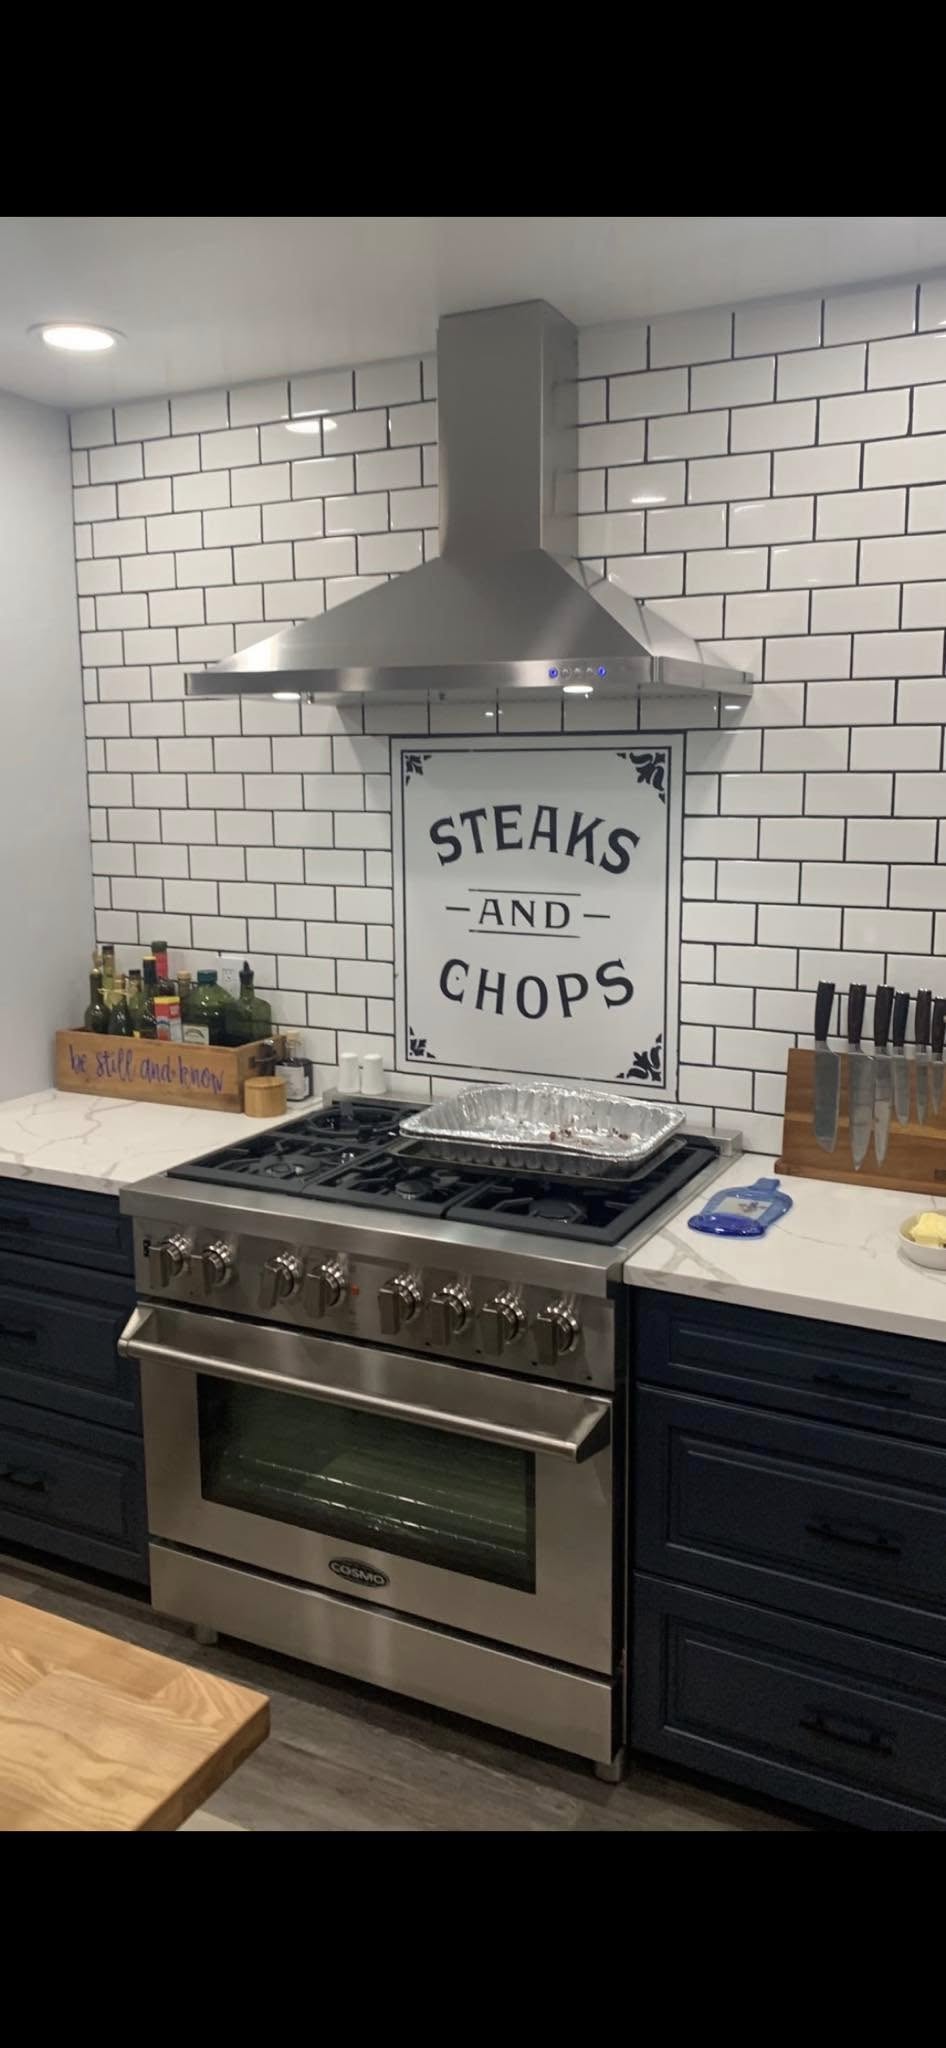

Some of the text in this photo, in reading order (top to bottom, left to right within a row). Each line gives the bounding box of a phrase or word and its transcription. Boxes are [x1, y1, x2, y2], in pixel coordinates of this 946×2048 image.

[429, 804, 640, 875] STEAKS
[479, 898, 571, 930] AND
[439, 958, 634, 1020] CHOPS
[68, 1044, 225, 1095] be still and know
[330, 1561, 386, 1586] COSMO
